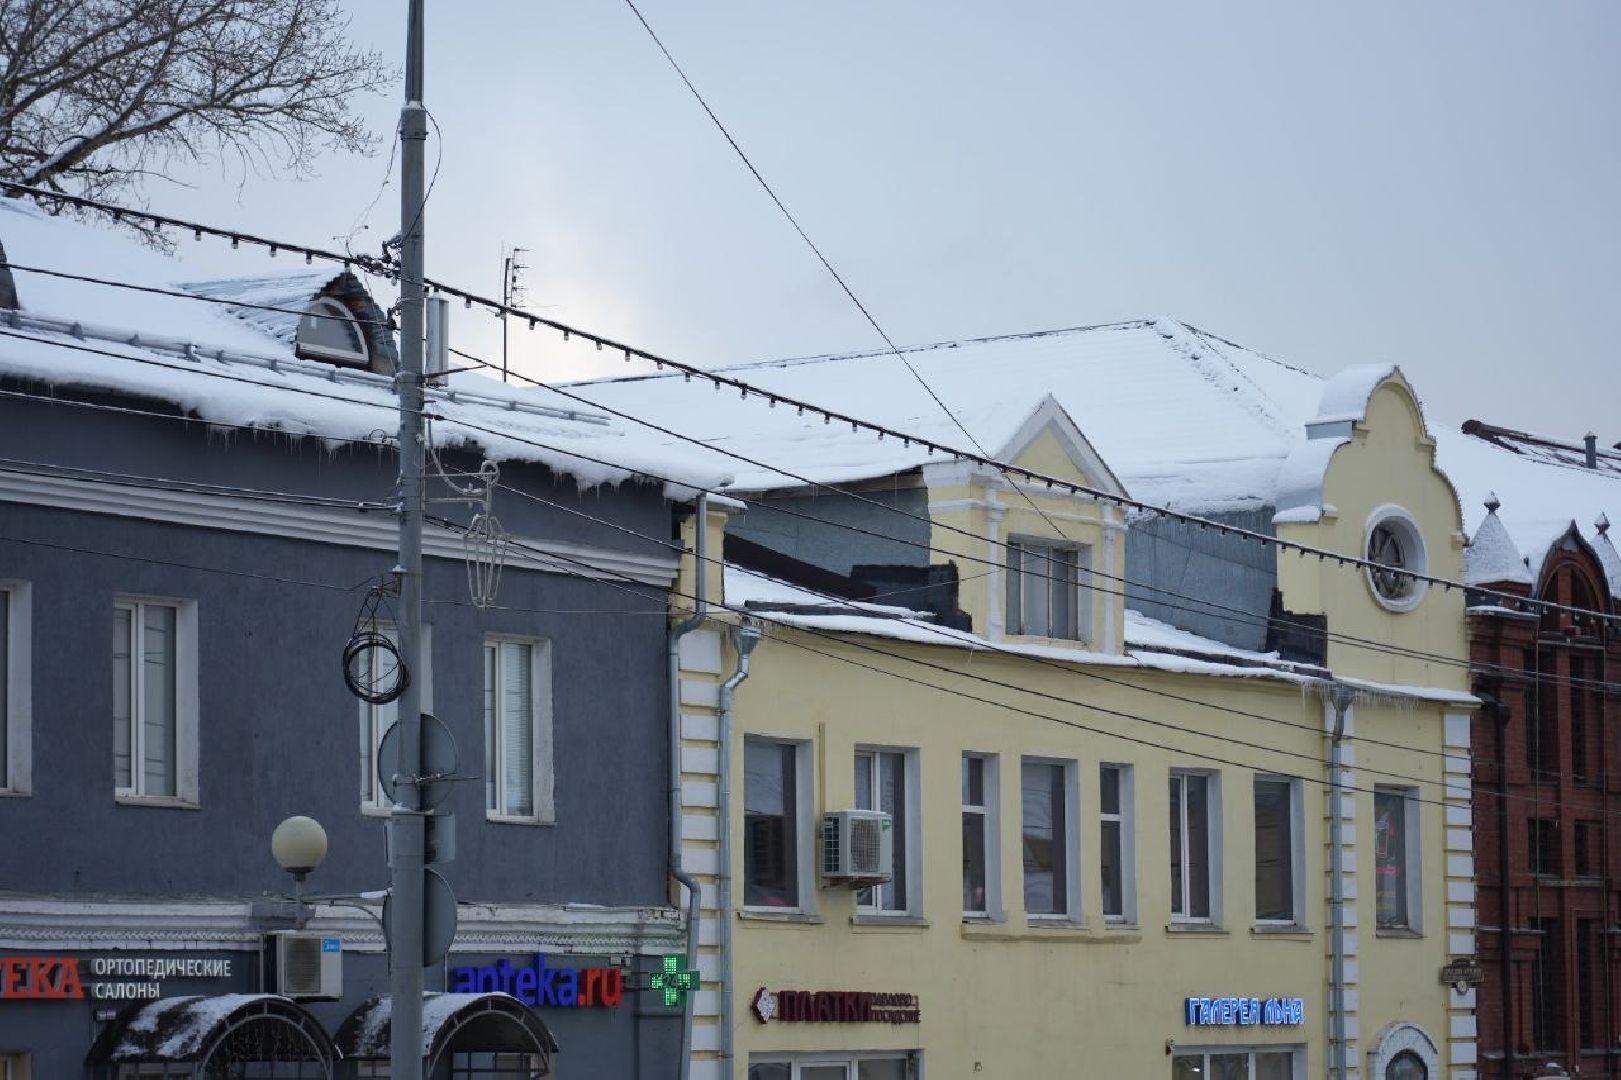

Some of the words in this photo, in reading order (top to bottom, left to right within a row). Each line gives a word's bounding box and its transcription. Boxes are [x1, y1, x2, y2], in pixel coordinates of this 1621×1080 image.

[0, 956, 84, 998] ЕКА
[95, 958, 231, 979] ОРТОПЕДИЧЕСКИЕ
[95, 982, 160, 998] САЛОНЫ
[781, 991, 872, 1022] ПЛАТКИ
[1187, 998, 1260, 1025] ГАЛЕРЕЯ
[1265, 998, 1304, 1025] ЛЬНА
